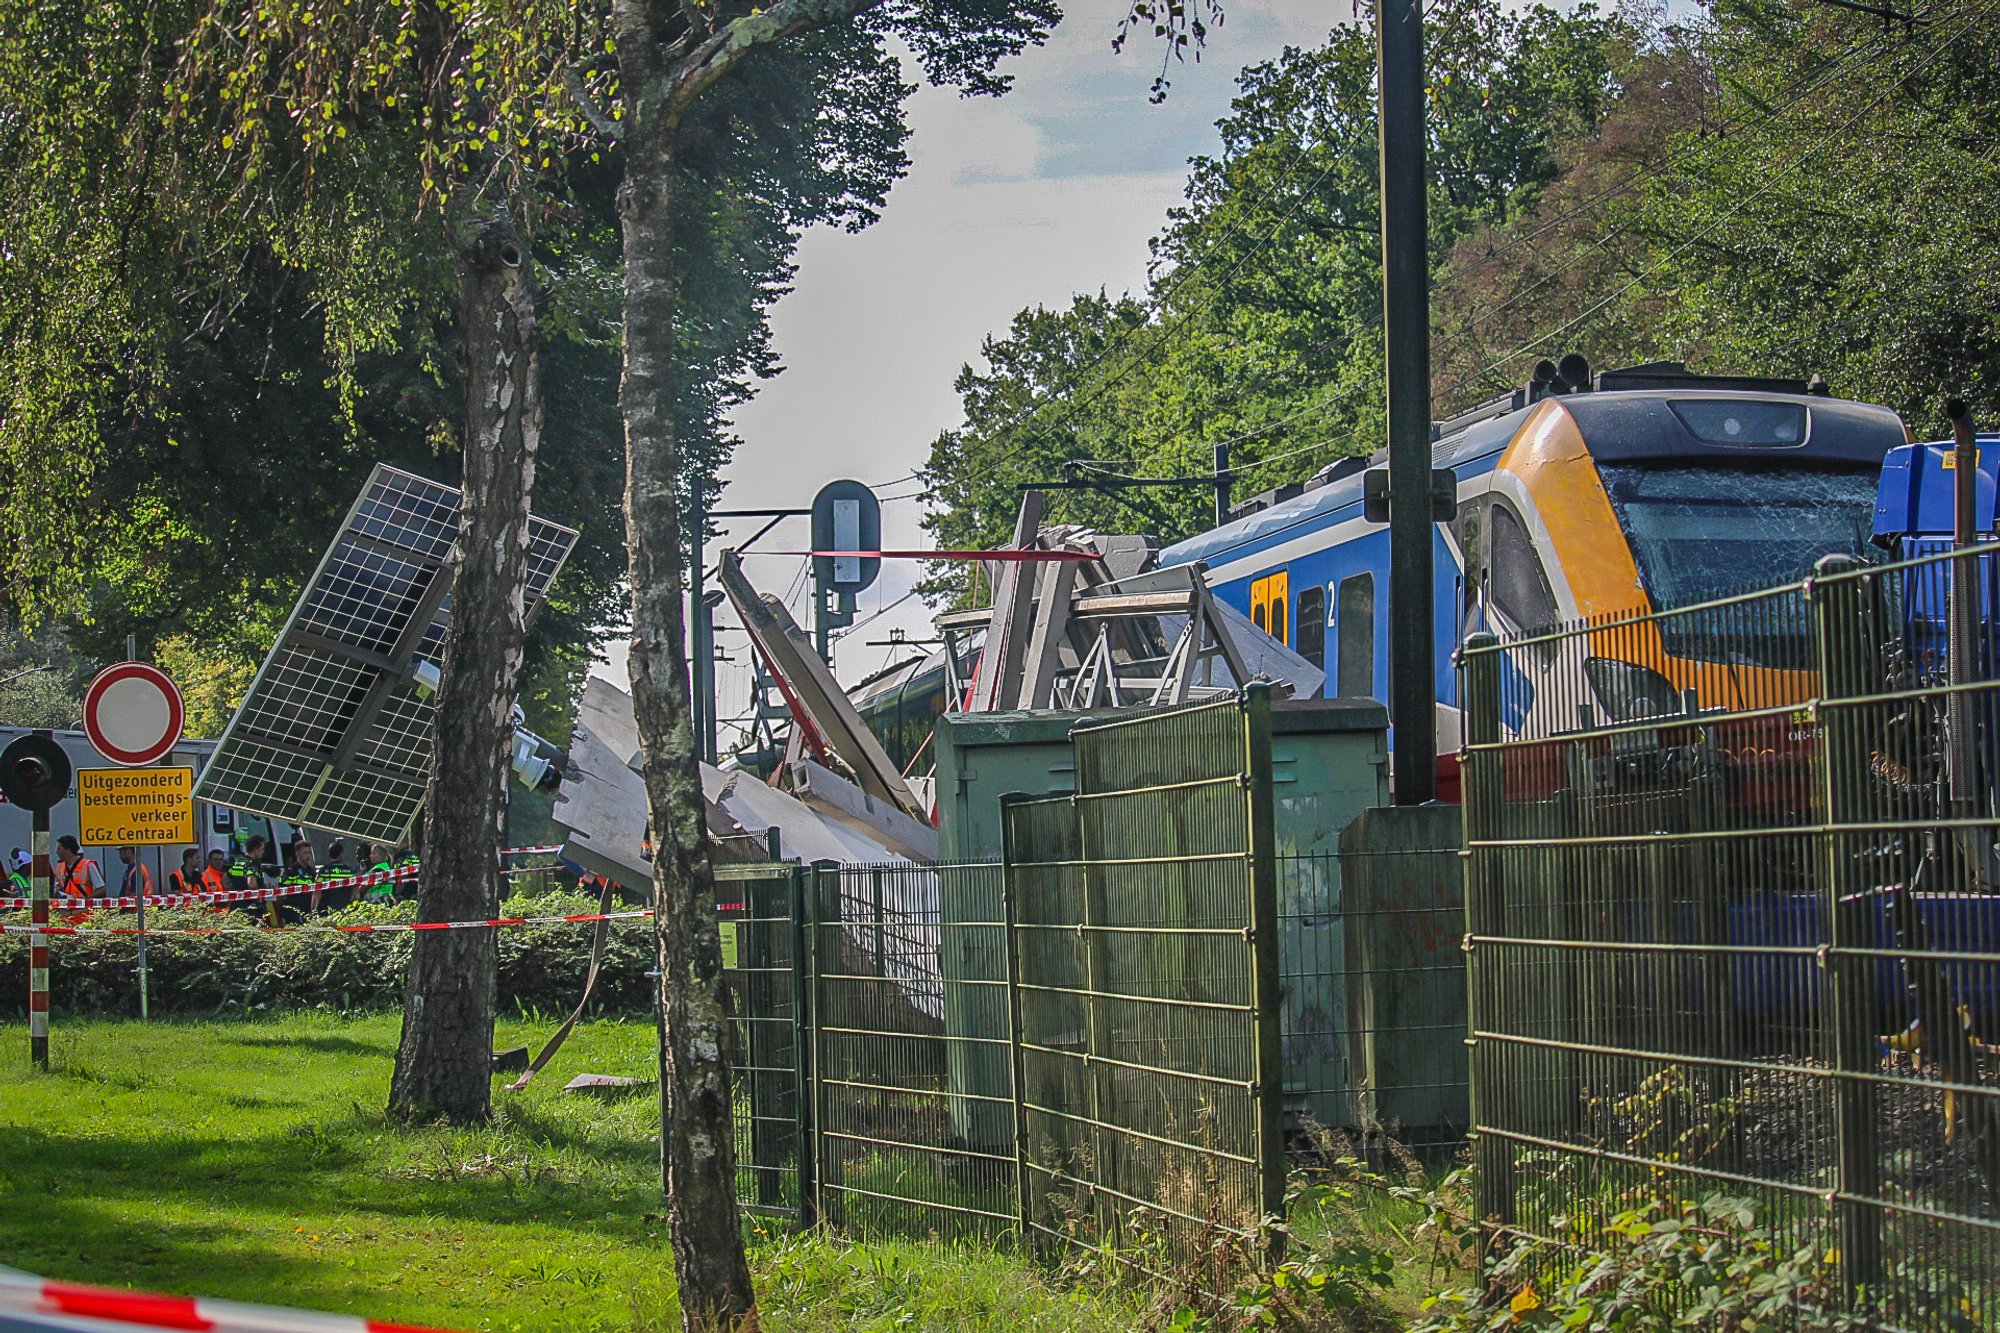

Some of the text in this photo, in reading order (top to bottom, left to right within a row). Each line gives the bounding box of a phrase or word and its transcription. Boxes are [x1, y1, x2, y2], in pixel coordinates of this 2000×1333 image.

[1327, 580, 1335, 628] 2
[83, 773, 183, 792] Uitgezonderd
[84, 791, 189, 807] bestemmings-
[131, 809, 187, 823] verkeer
[85, 826, 179, 841] GGz Centraal
